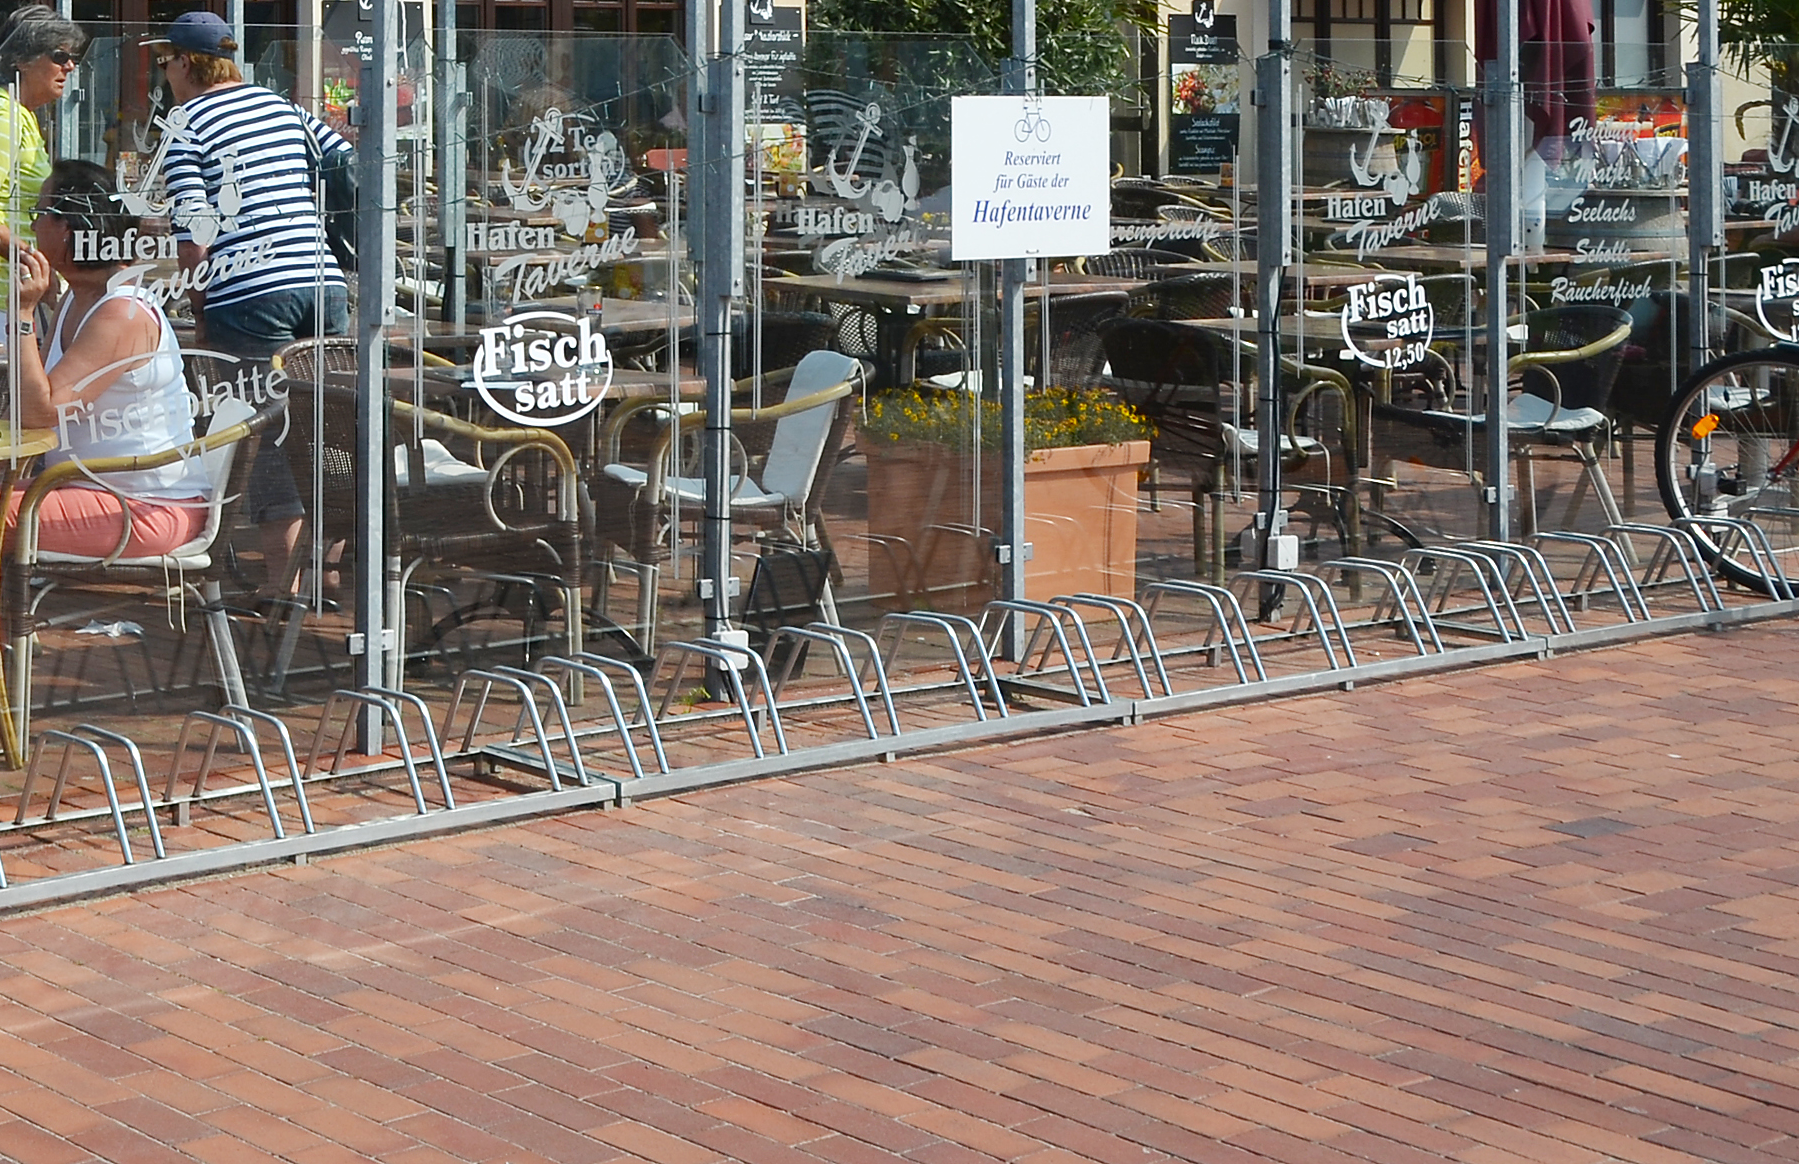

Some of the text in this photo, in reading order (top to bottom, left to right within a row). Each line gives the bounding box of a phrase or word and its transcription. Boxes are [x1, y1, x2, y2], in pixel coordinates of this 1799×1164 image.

[1004, 150, 1061, 166] Reserviert
[993, 173, 1070, 193] für Gäste der
[1749, 179, 1797, 202] Hafen
[797, 206, 874, 235] Hafen
[972, 199, 1092, 229] Hafentaverne
[1327, 193, 1387, 219] Hafen
[1568, 196, 1637, 223] Seelachs
[466, 219, 556, 252] Hafen
[1346, 197, 1442, 261] Taverne
[72, 228, 179, 262] Hafen
[1573, 238, 1632, 264] Scholle
[107, 236, 277, 320] Taverne
[494, 225, 640, 305] Taverne
[1347, 273, 1428, 323] Fisch
[1551, 274, 1652, 307] Räucherfisch
[1386, 309, 1429, 339] satt
[479, 316, 610, 378] Fisch
[1384, 342, 1425, 370] 12,50
[515, 372, 593, 413] satt
[55, 365, 290, 452] Fischplatte
